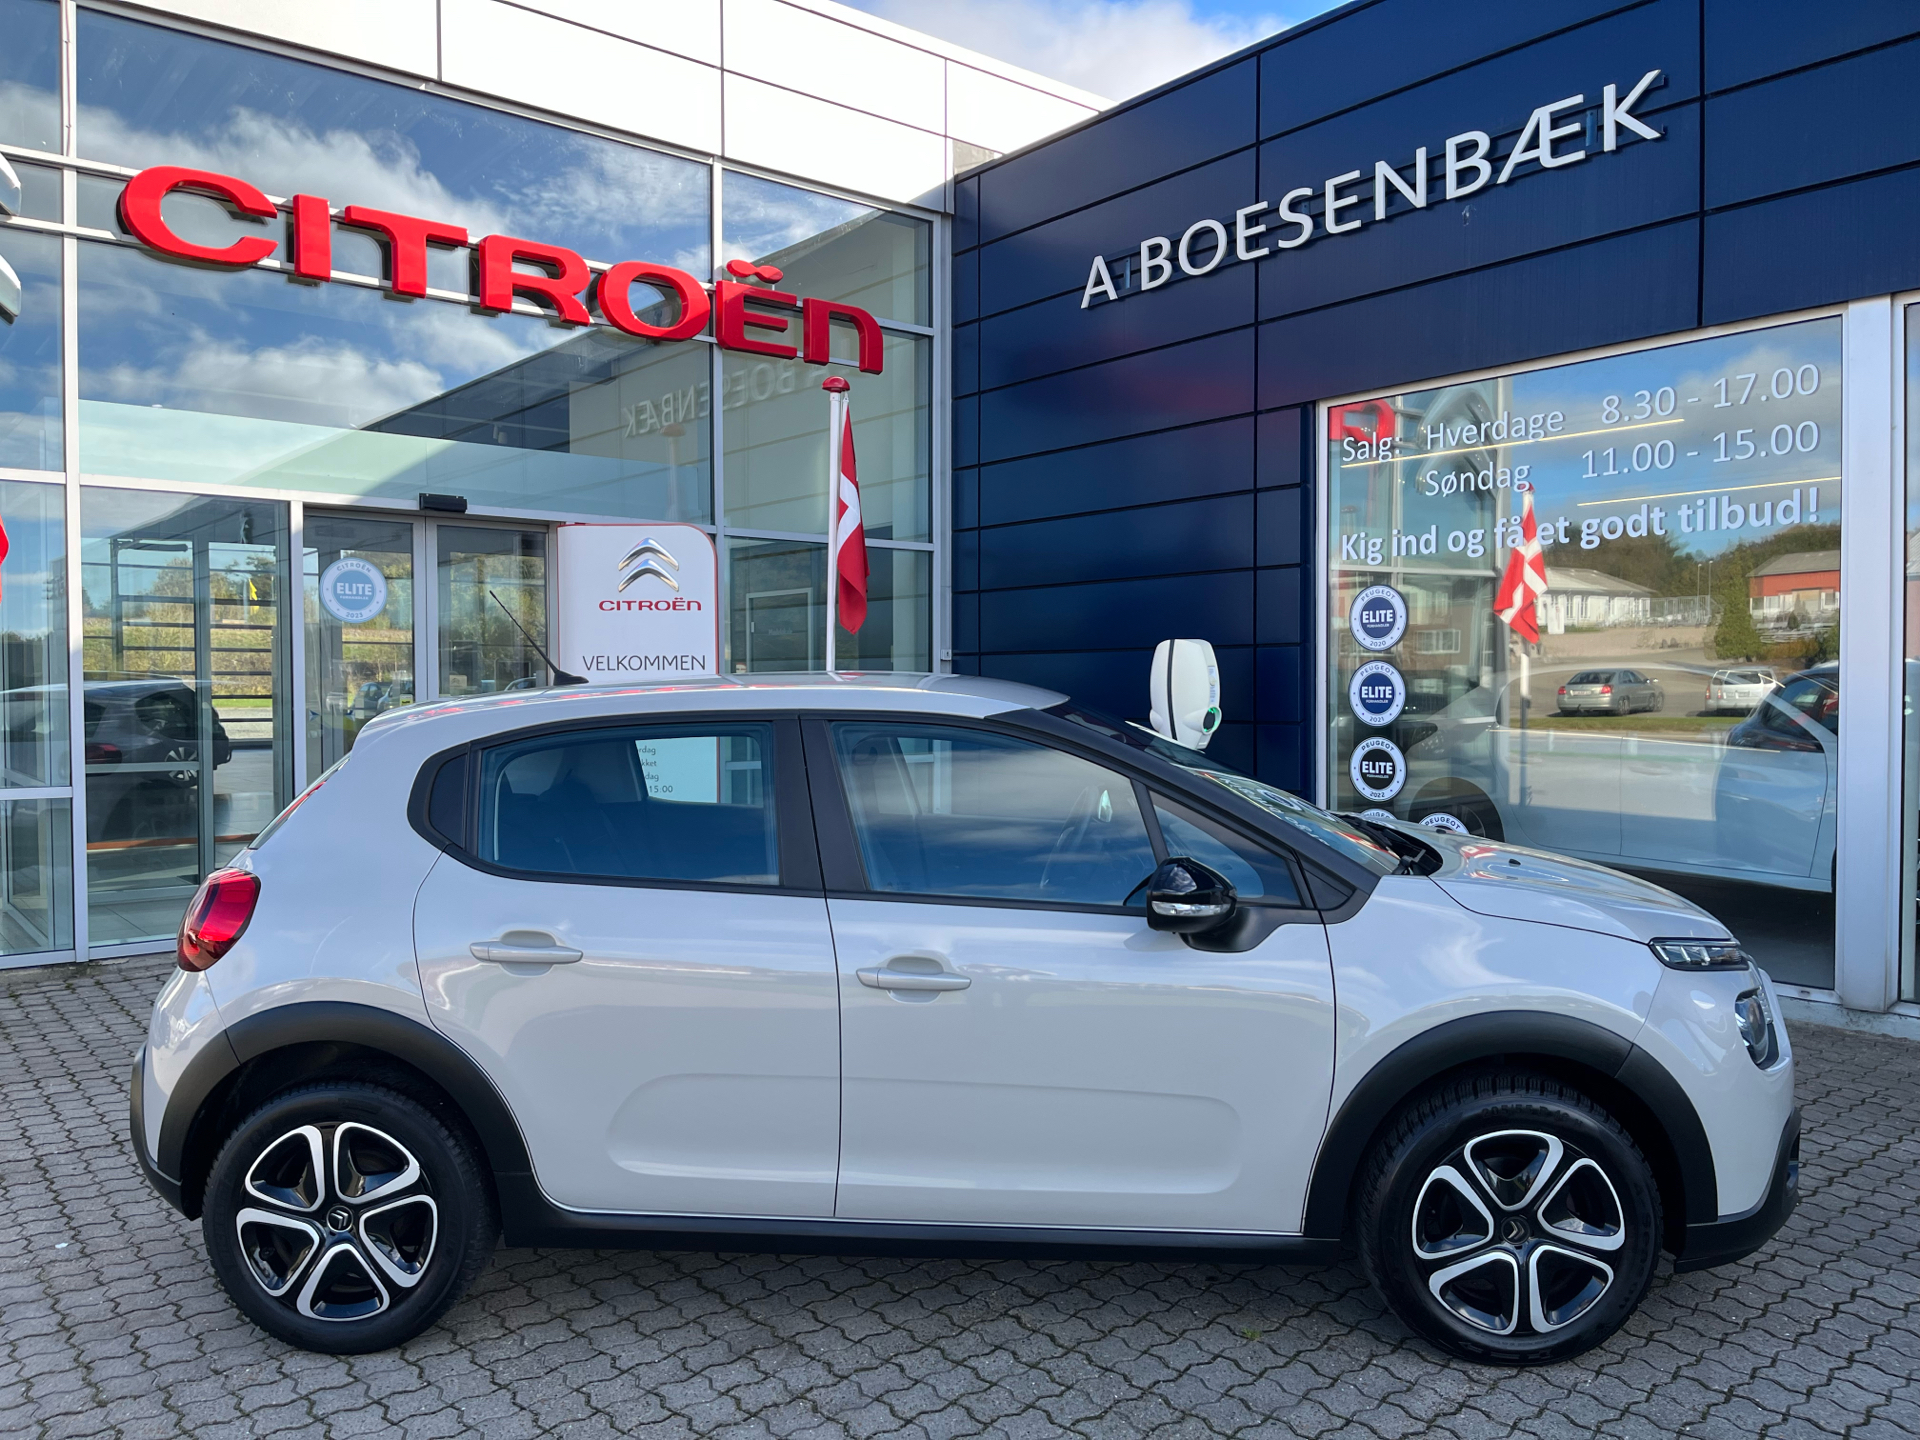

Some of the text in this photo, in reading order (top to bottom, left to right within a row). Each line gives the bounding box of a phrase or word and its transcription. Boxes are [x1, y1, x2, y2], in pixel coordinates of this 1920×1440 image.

[1081, 69, 1662, 309] A BOESENBÆK
[1342, 431, 1402, 463] Salg:
[1427, 410, 1565, 450] Hverdage
[1601, 386, 1677, 425] 8.30
[1713, 363, 1820, 409] 17.00
[1425, 461, 1532, 498] Søndag
[1582, 439, 1676, 479] 11.00
[1713, 420, 1820, 464] 15.00
[1341, 486, 1820, 566] Kig ind og få et godt tilbud!
[336, 562, 372, 573] CITROËN
[336, 582, 373, 596] ELITE
[1361, 588, 1396, 602] PEUGEOT
[598, 597, 702, 611] CITROËN
[1362, 609, 1394, 624] ELITE
[582, 655, 706, 671] VELKOMMEN
[1360, 664, 1395, 677] PEUGEOT
[1361, 686, 1393, 699] ELITE
[1361, 740, 1395, 751] PEUGEOT
[1362, 761, 1393, 775] ELITE
[1424, 816, 1461, 830] PEUGEOT
